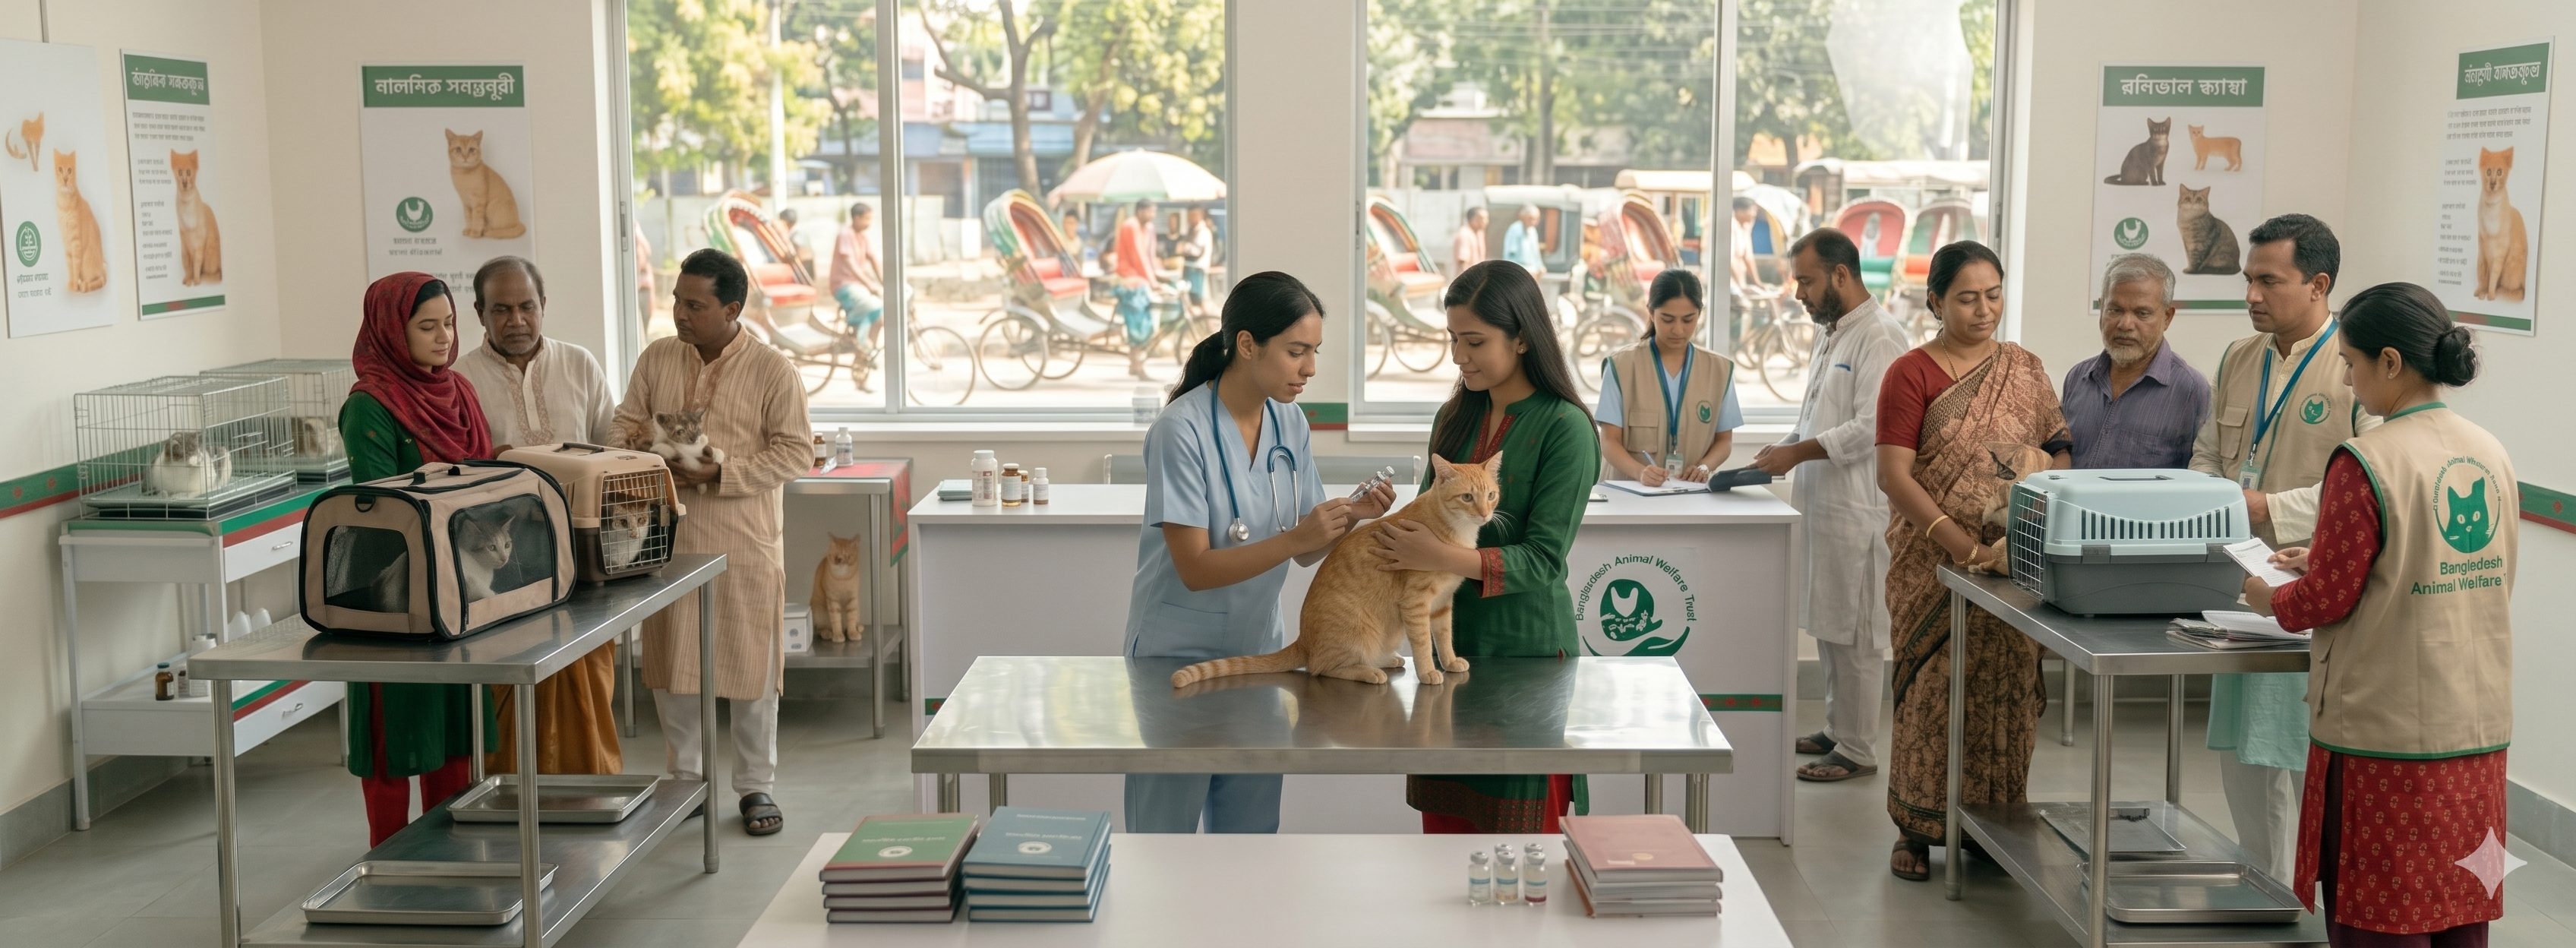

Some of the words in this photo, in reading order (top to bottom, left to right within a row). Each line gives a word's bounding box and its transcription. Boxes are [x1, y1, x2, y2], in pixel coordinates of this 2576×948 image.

[1615, 554, 1654, 567] Animal
[1656, 558, 1688, 592] Welfare
[2410, 579, 2456, 595] Animal
[2458, 575, 2502, 591] Welfare
